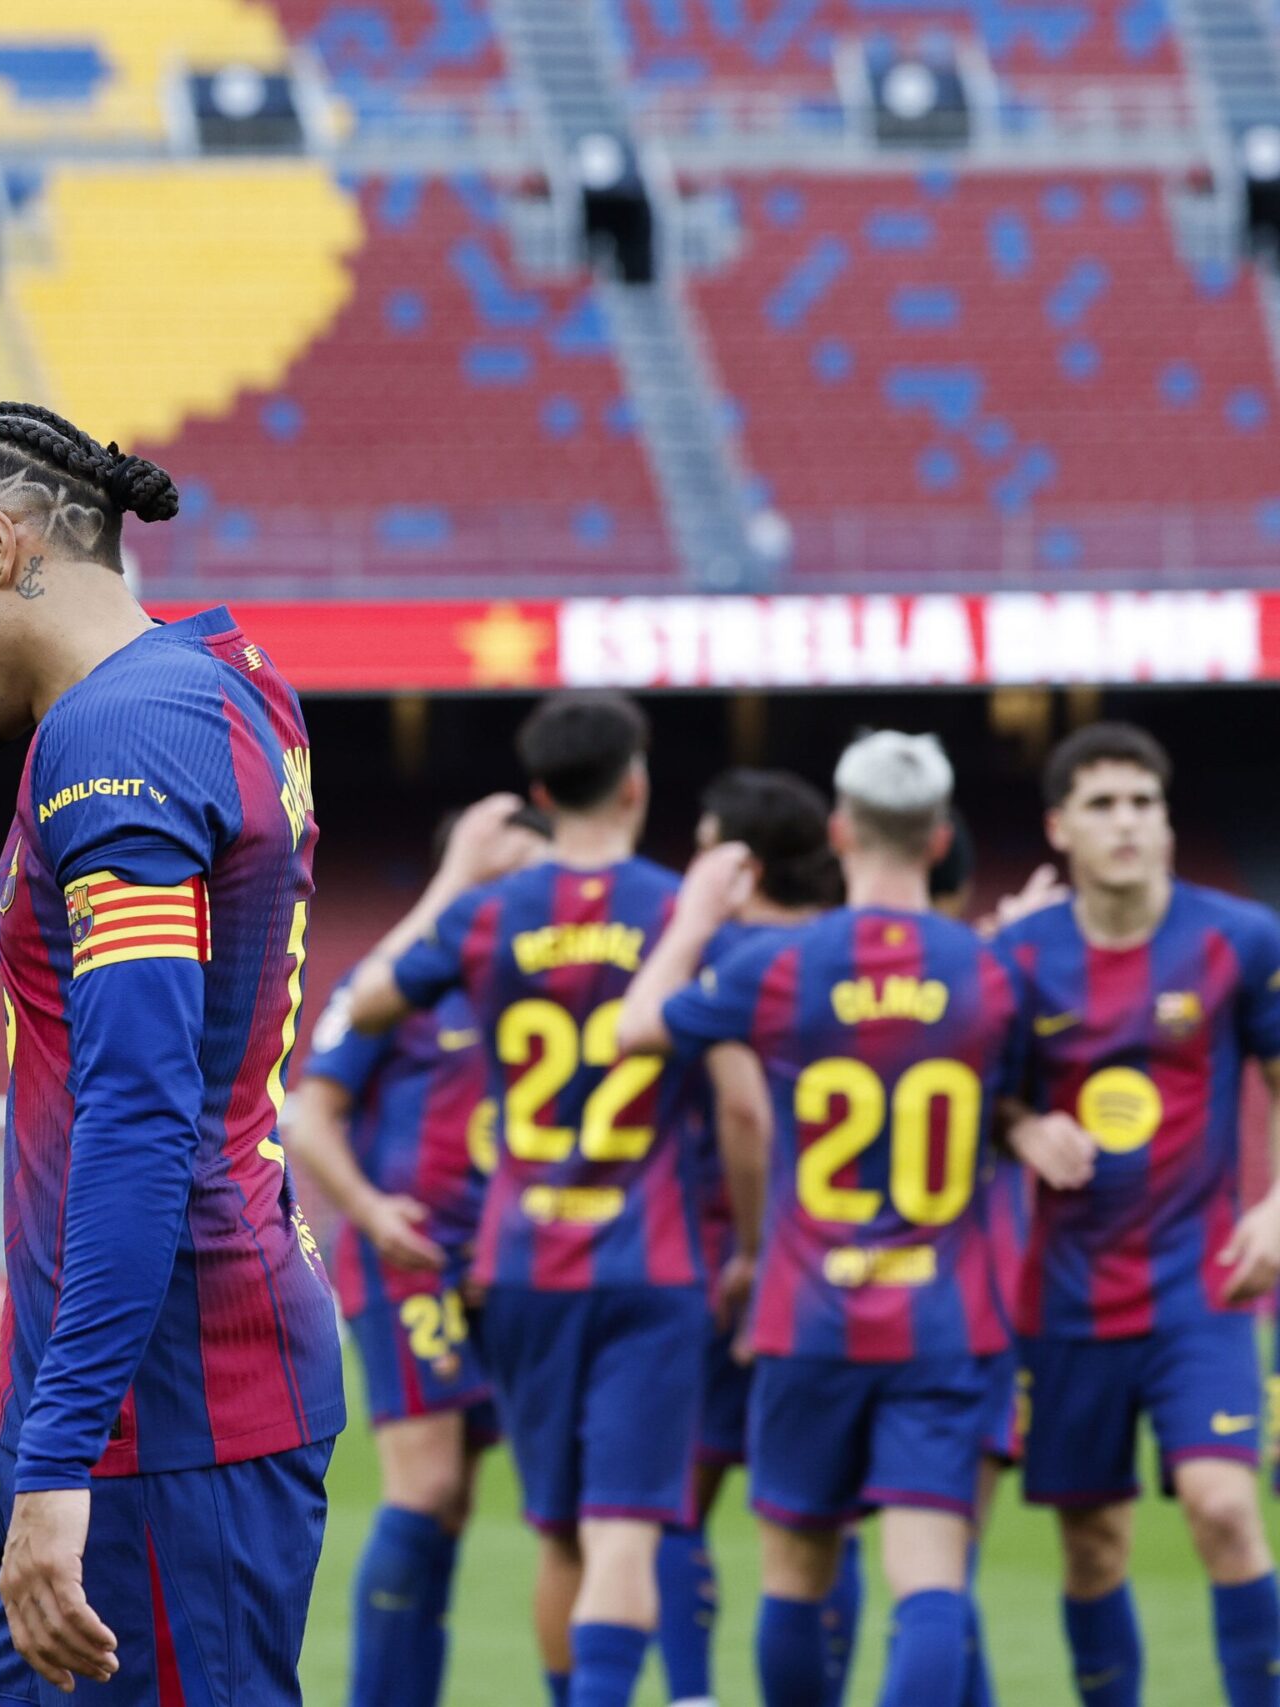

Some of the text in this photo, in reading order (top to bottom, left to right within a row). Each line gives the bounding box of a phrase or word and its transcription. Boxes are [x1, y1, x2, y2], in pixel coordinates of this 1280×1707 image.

[39, 777, 145, 823] AMBILIGHT
[496, 997, 665, 1162] 22
[794, 1056, 982, 1227] 20
